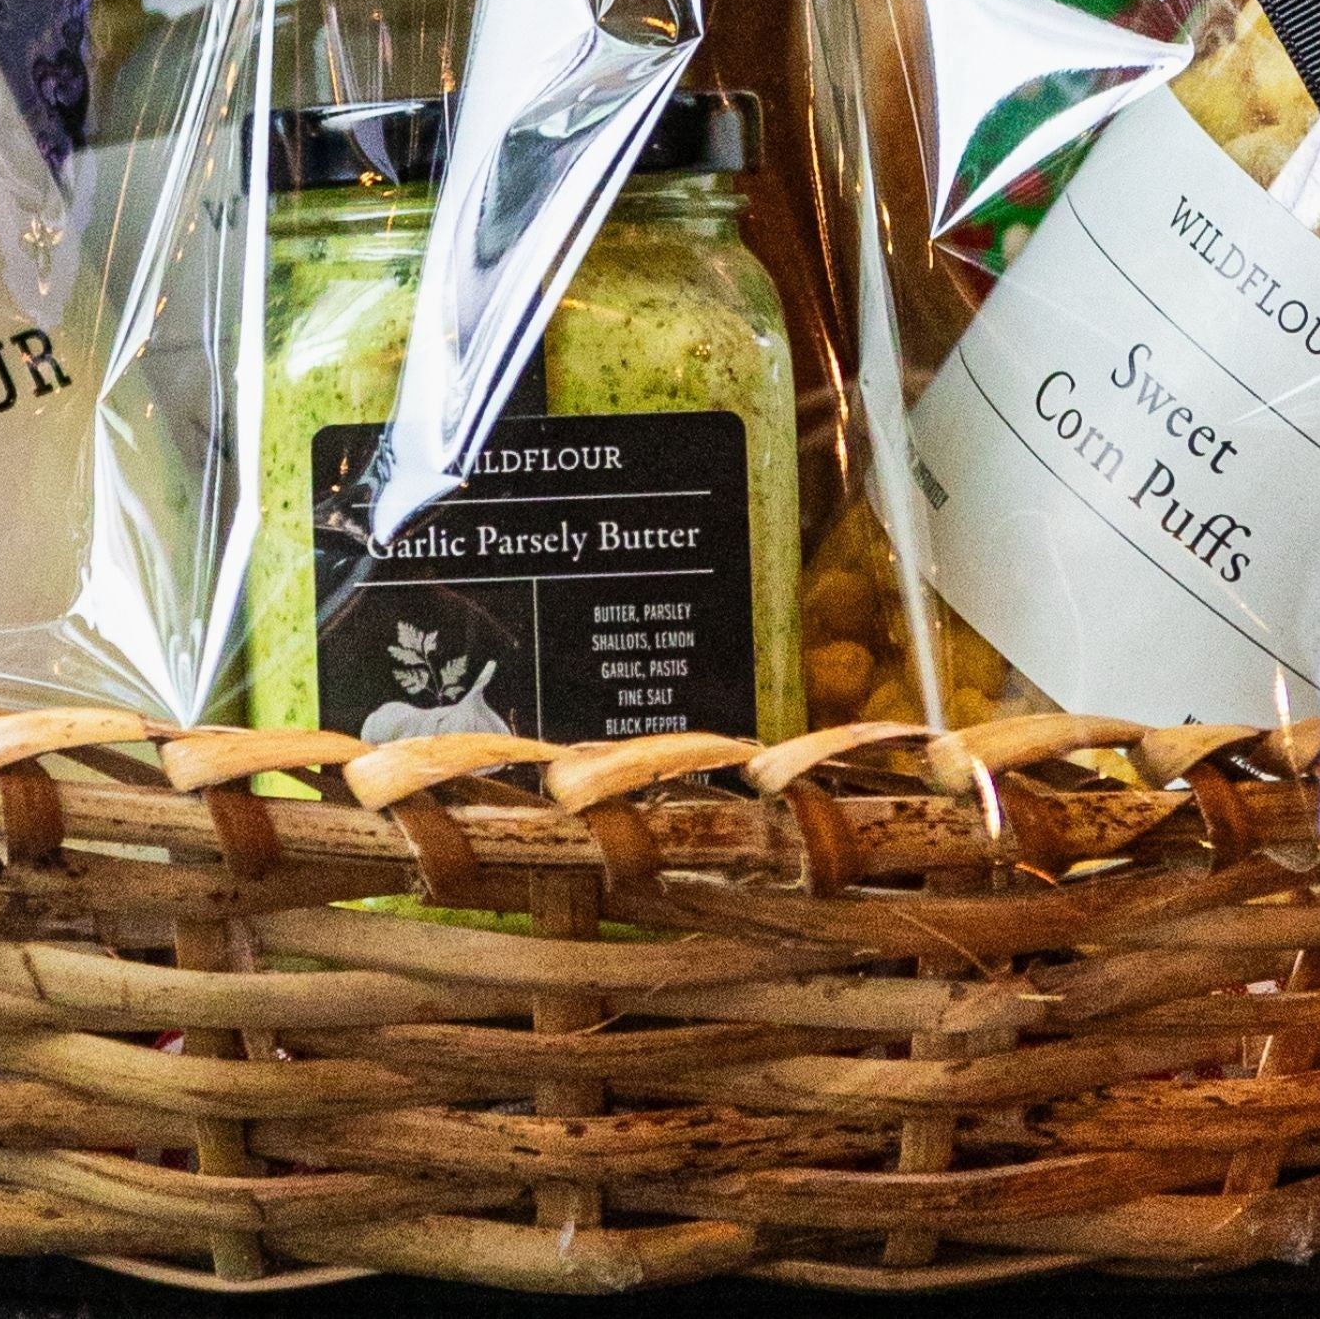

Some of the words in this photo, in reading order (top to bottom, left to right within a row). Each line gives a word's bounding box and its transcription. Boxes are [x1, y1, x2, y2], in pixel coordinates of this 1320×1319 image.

[1110, 343, 1238, 475] Sweet
[1035, 370, 1125, 483] Corn
[1127, 458, 1252, 583] Puffs
[367, 525, 466, 560] Garlic
[476, 520, 588, 562] Parsely
[598, 520, 701, 552] Butter
[593, 604, 640, 624] BUTTER,
[643, 602, 692, 621] PARSLEY
[591, 632, 652, 652] SHALLOTS,
[655, 631, 695, 649] LEMON
[601, 661, 646, 680] GARLIC,
[649, 659, 689, 677] PASTIS
[618, 689, 644, 706] FINE
[646, 688, 674, 705] SALT
[605, 717, 642, 735] BLACK
[645, 715, 688, 733] PEPPER
